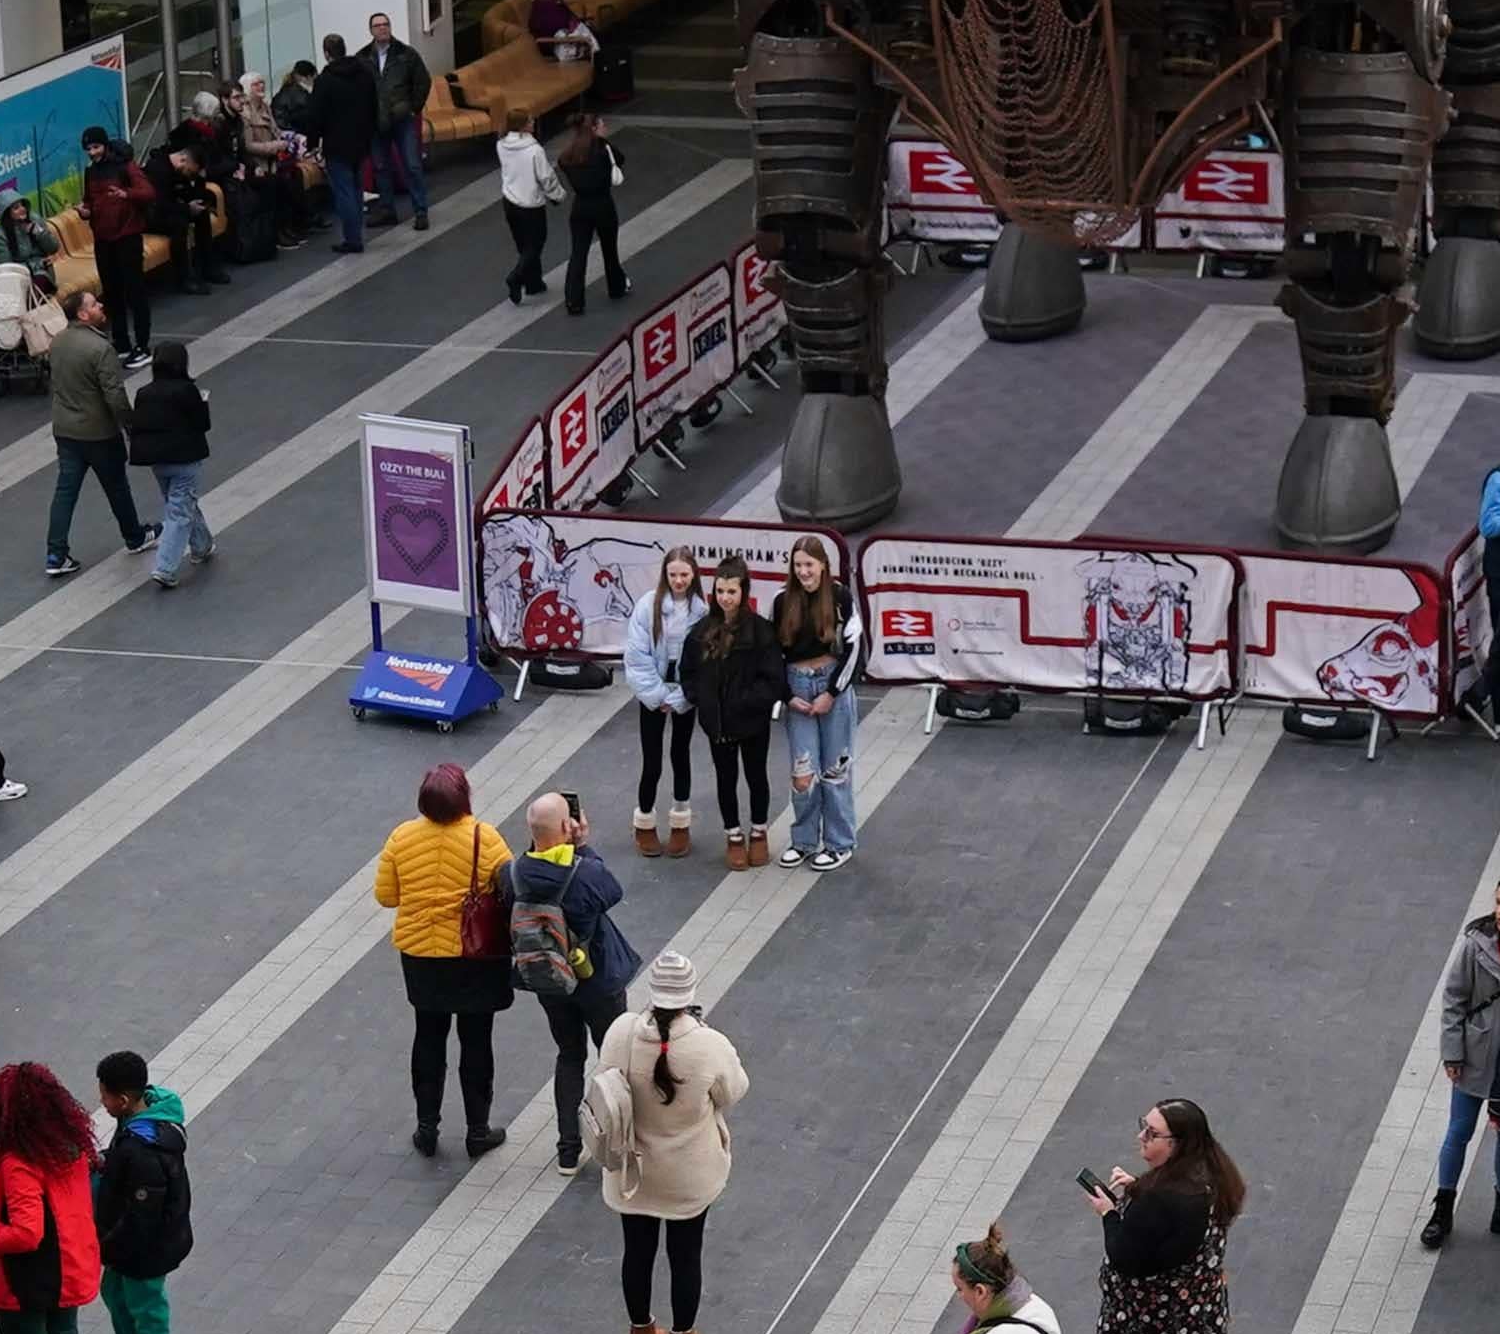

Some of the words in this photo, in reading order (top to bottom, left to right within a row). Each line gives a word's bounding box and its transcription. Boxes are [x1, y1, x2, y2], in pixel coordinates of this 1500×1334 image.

[380, 461, 405, 474] OZZY
[405, 465, 423, 478] THE
[423, 468, 446, 480] BULL
[684, 544, 789, 564] IRMINGHAM'S
[910, 555, 973, 566] INTRODUCING
[883, 565, 949, 576] BIRMINGHAM'S
[953, 569, 1010, 579] MECHANICAL
